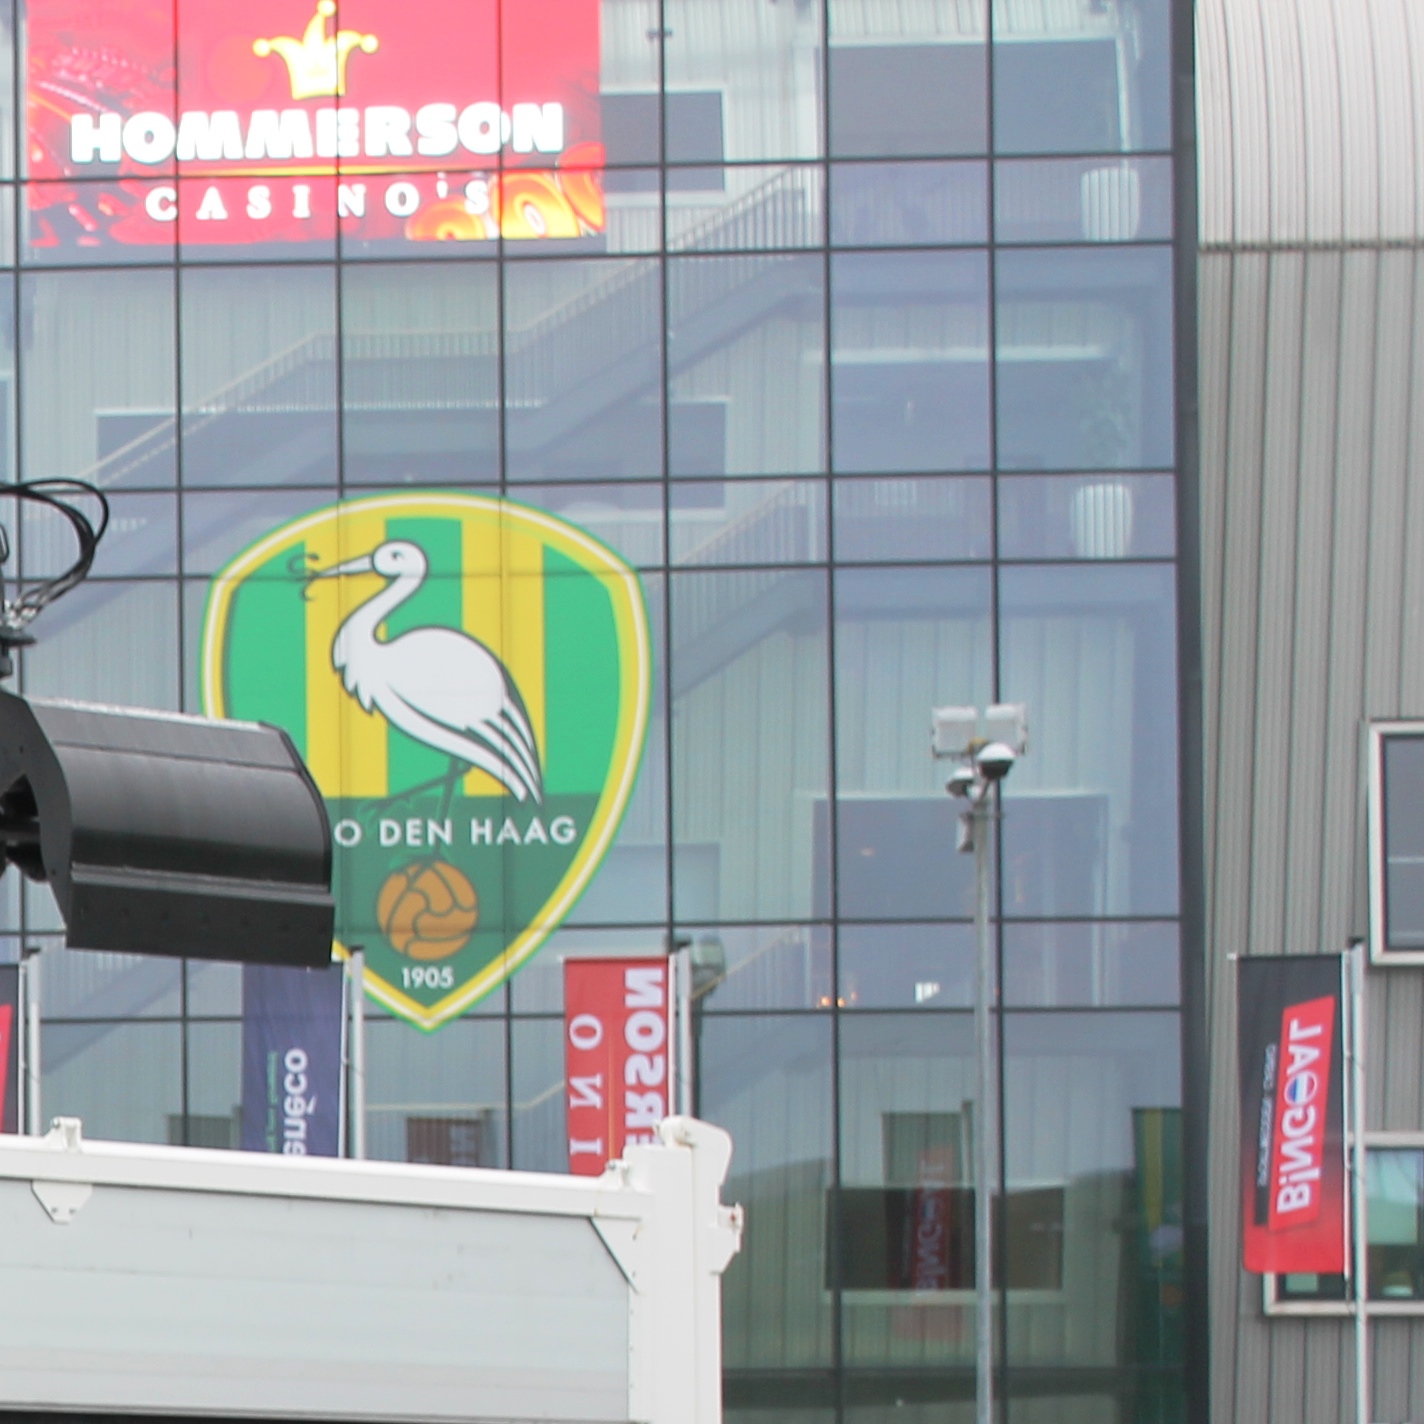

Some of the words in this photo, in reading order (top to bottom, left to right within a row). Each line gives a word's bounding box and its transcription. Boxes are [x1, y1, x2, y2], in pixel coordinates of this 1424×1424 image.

[70, 102, 564, 163] HOMMERSON
[144, 172, 492, 222] CASINO'S
[380, 819, 453, 847] DEN
[470, 816, 577, 847] HAAG
[400, 965, 454, 991] 1905
